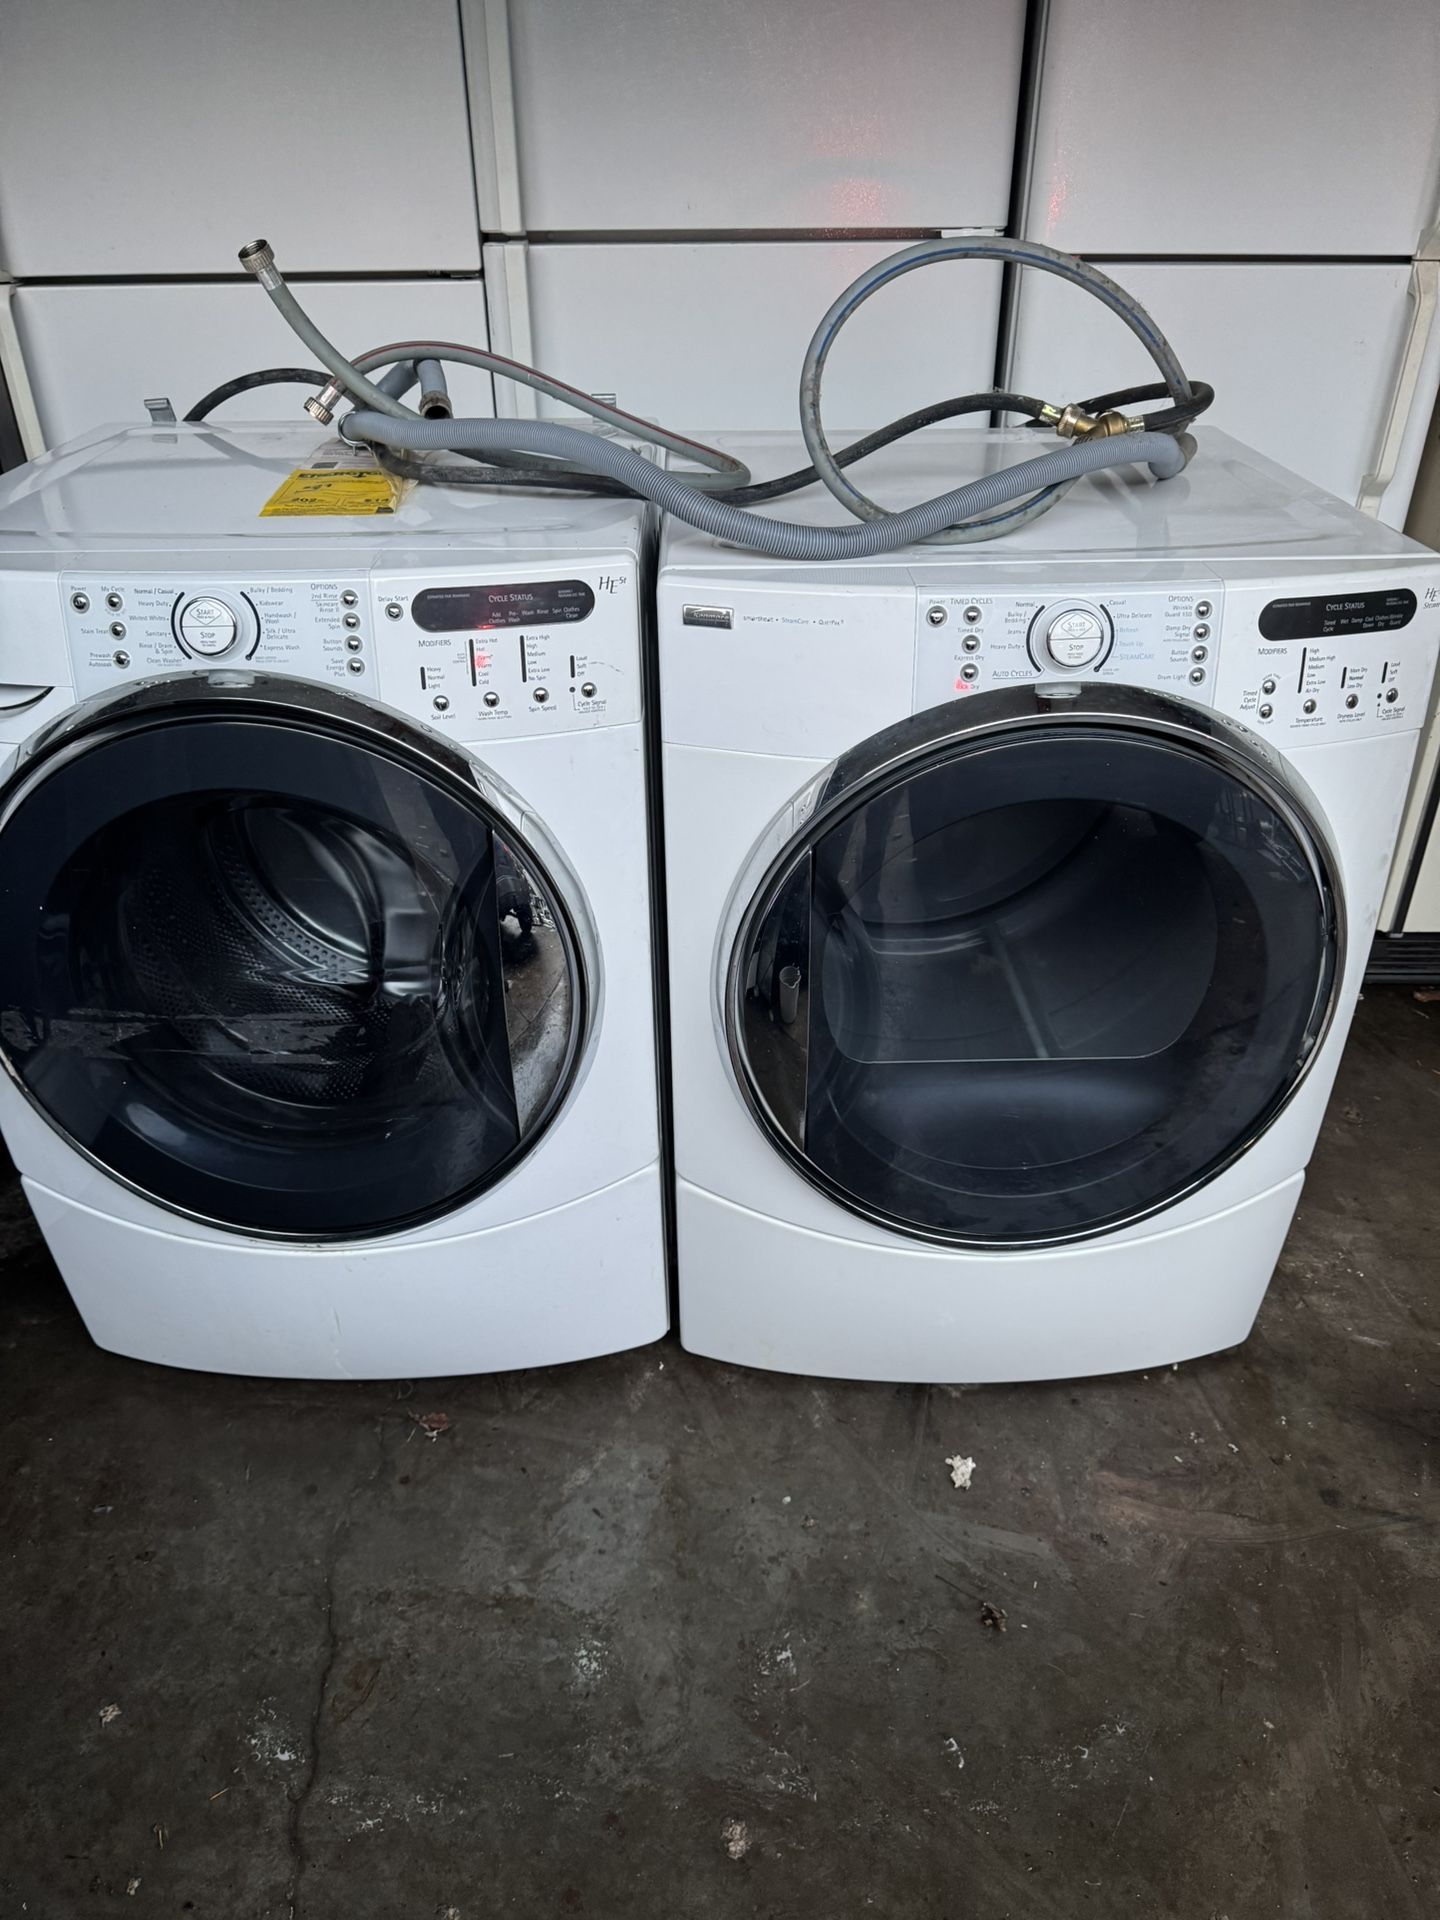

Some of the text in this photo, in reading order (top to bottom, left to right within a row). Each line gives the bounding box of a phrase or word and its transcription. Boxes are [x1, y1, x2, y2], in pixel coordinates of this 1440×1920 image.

[488, 593, 534, 603] CYCLE STATUS
[1326, 602, 1365, 611] CYCLE STATUS
